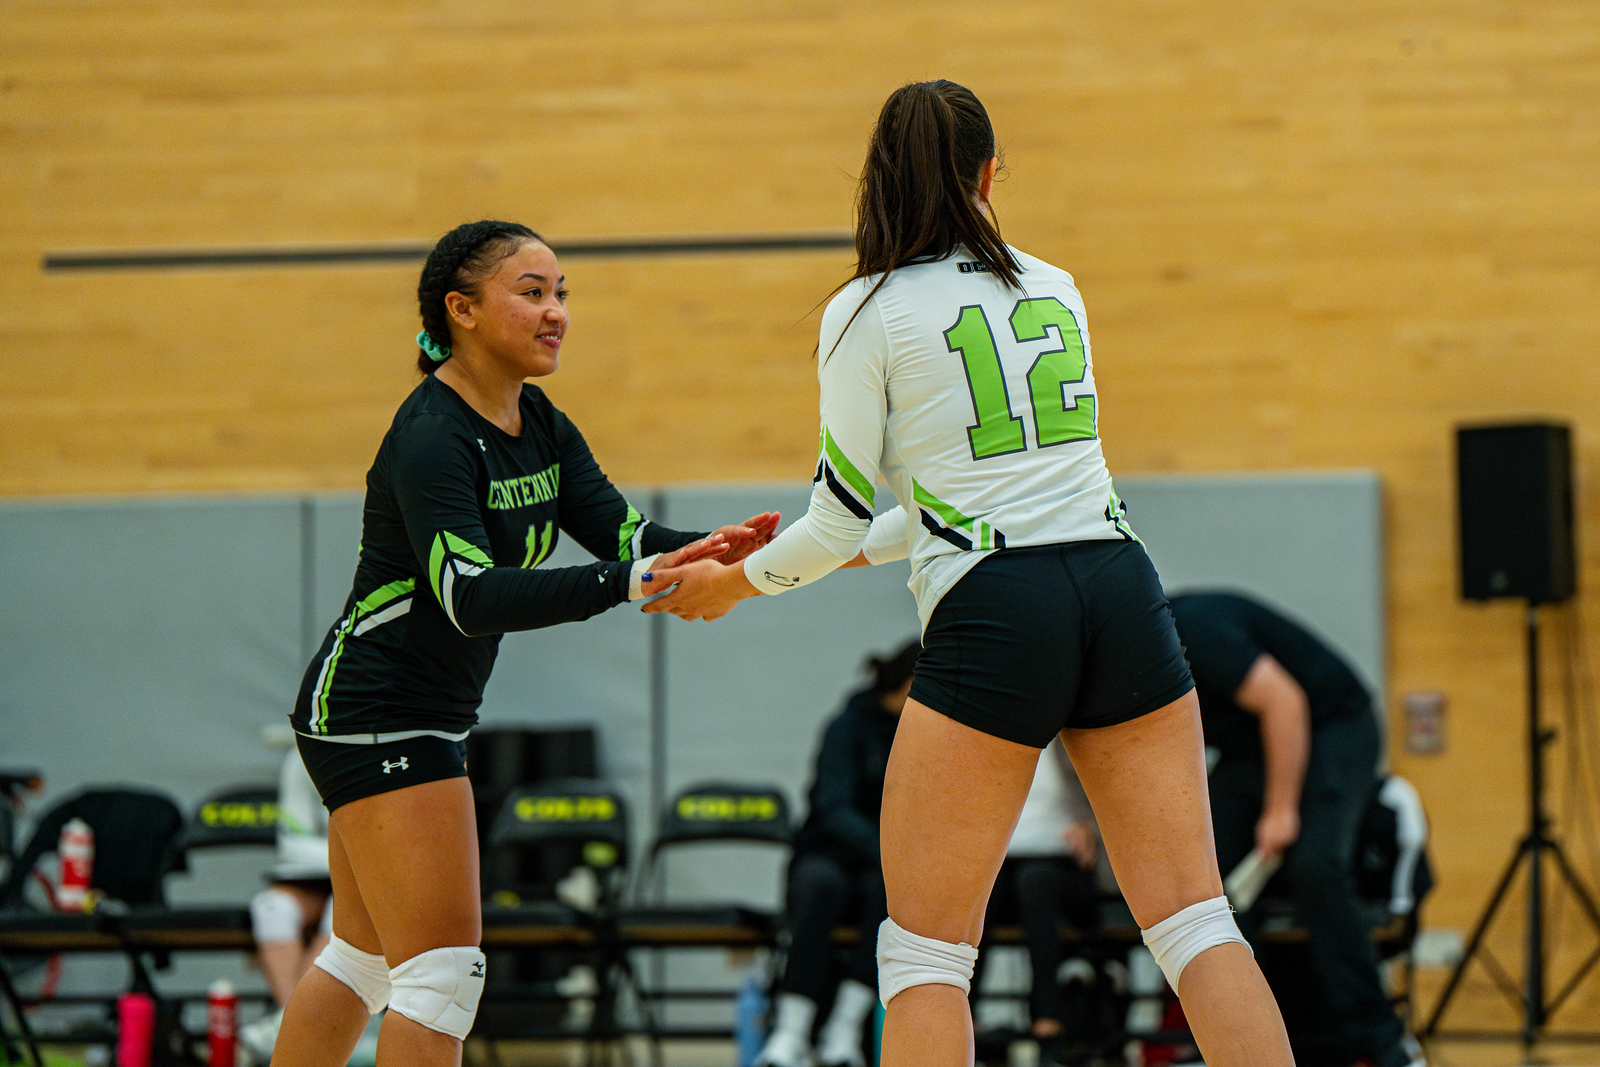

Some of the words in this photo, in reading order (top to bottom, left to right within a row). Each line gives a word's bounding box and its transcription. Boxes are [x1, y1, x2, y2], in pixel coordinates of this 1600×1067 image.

[942, 296, 1098, 461] 12
[487, 462, 560, 510] CNTENNI
[520, 520, 553, 569] 11
[201, 801, 278, 829] COLT
